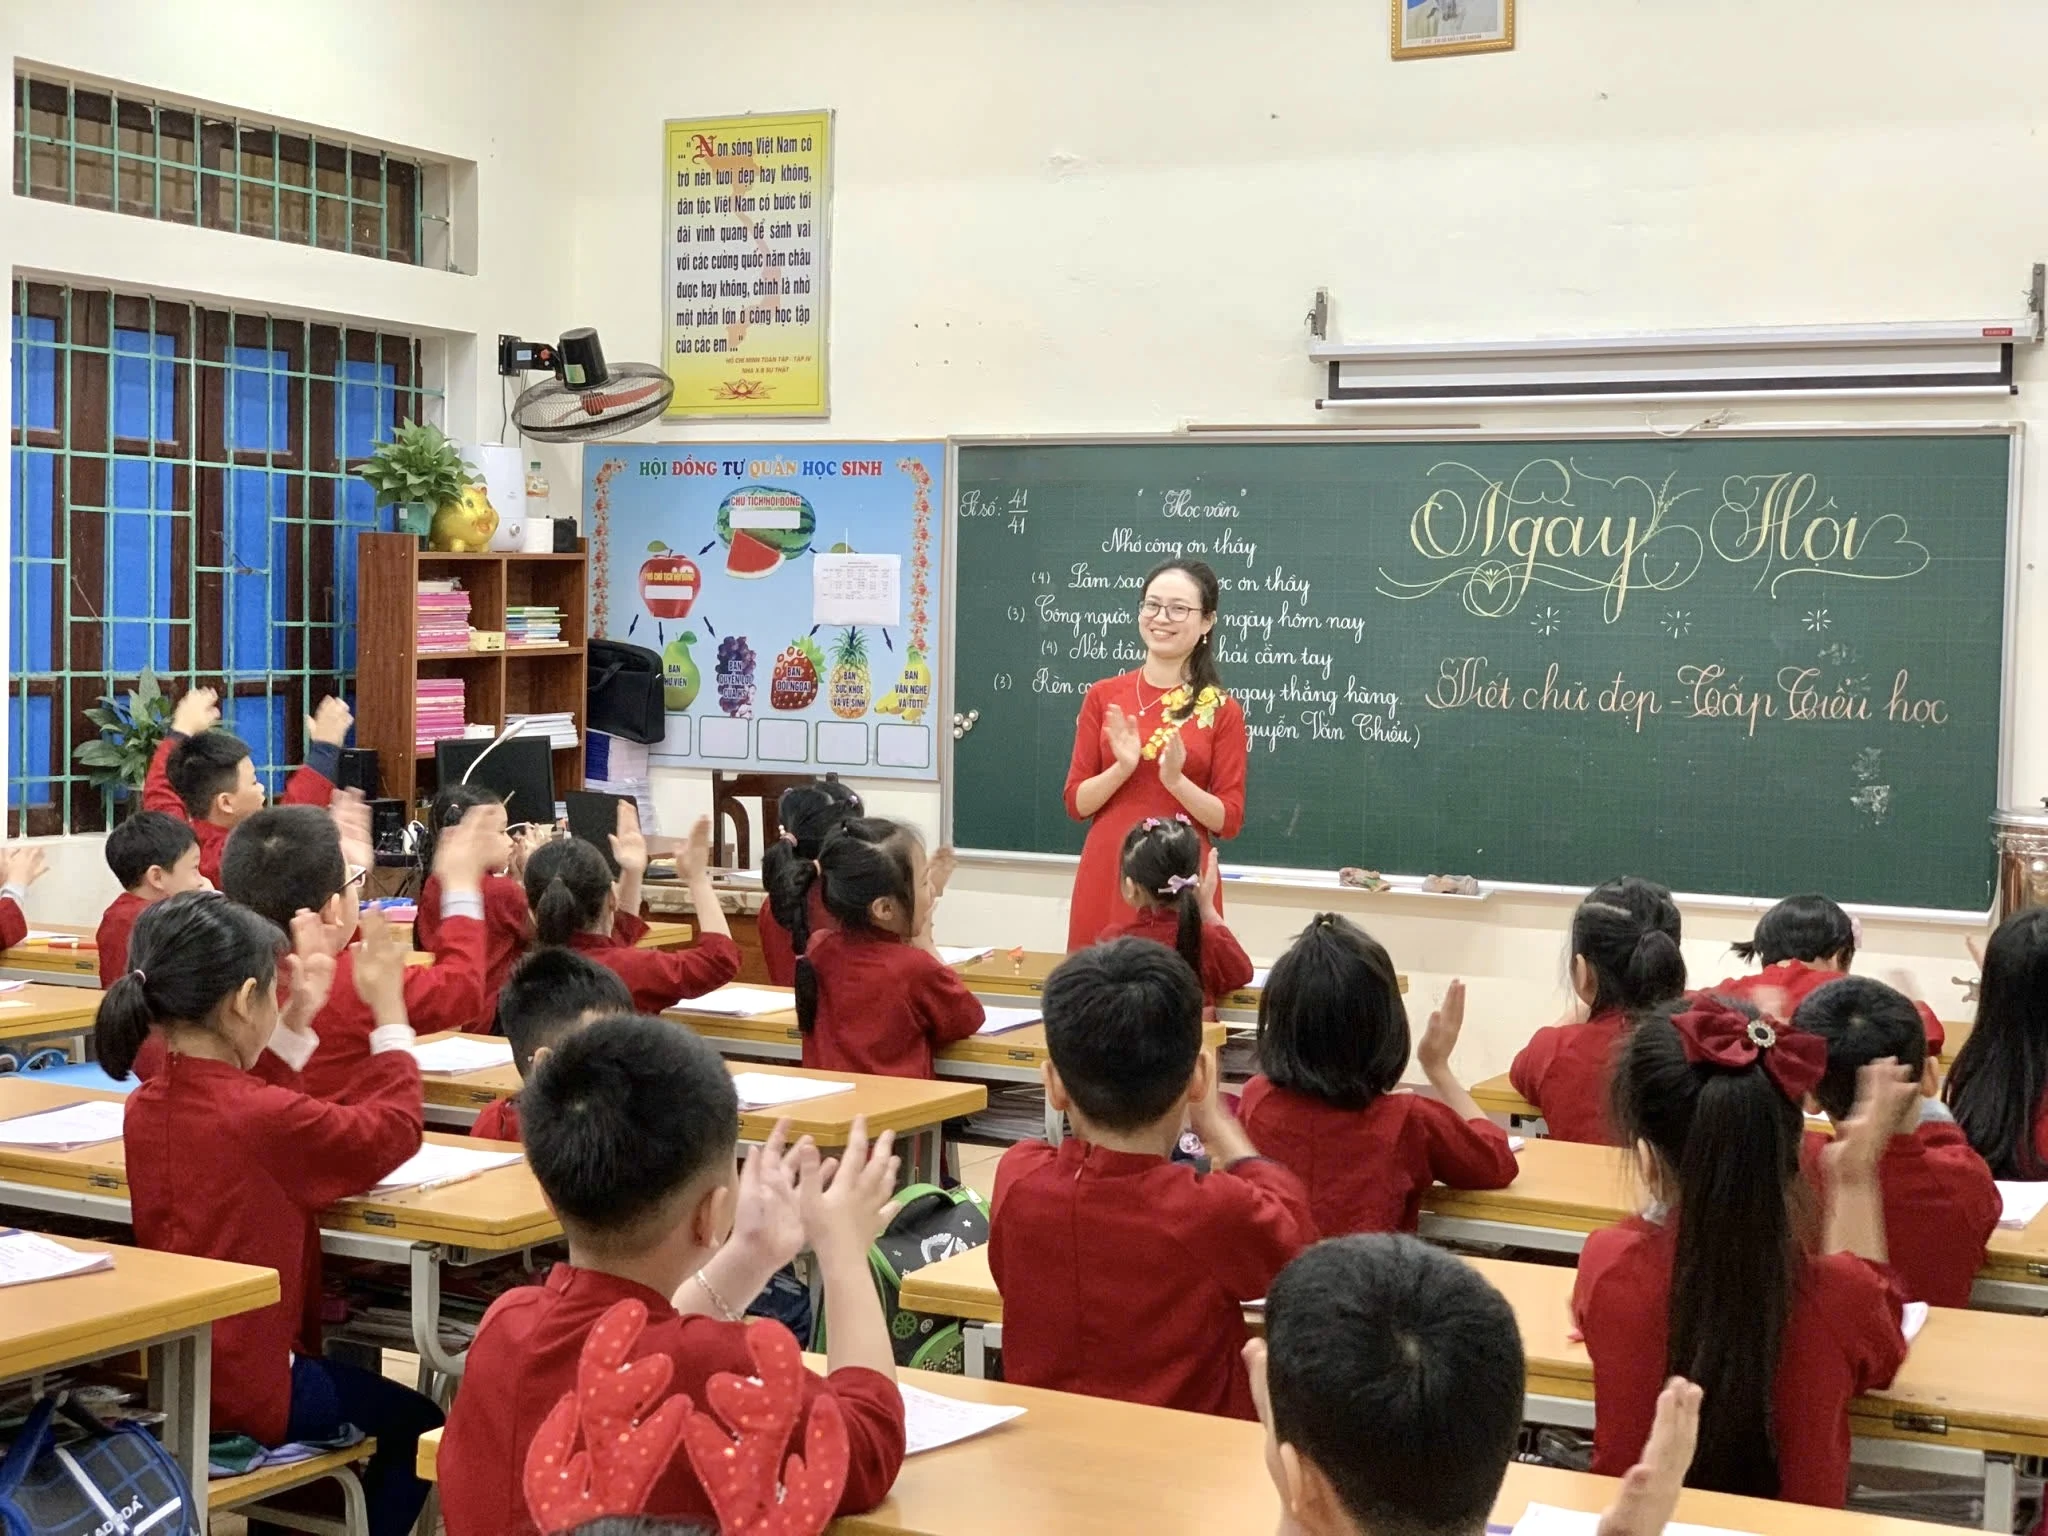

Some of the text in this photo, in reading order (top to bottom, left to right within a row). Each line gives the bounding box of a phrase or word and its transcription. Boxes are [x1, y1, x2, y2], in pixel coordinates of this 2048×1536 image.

[756, 136, 773, 158] Việt
[777, 136, 797, 153] Nam
[695, 169, 711, 186] nên
[738, 167, 754, 187] đẹp
[760, 165, 776, 184] hay
[678, 192, 811, 218] dân tộc Việt Nam có bước tới
[677, 225, 691, 243] đài
[721, 226, 748, 243] quang
[754, 218, 766, 239] để
[770, 221, 791, 240] sánh
[797, 220, 811, 238] vai
[677, 247, 811, 270] với các cường quốc năm châu
[677, 281, 698, 301] được
[701, 281, 717, 299] hay
[720, 279, 750, 299] không,
[782, 276, 790, 295] là
[793, 274, 810, 294] nhờ
[676, 308, 693, 330] một
[722, 306, 736, 325] lớn
[750, 307, 771, 326] công
[775, 306, 792, 327] học
[796, 304, 810, 326] tập
[676, 335, 692, 353] của
[695, 336, 711, 353] các
[639, 457, 667, 480] HỘI
[672, 453, 717, 477] ĐỒNG
[723, 458, 746, 480] TỰ
[802, 461, 836, 480] HỌC
[841, 461, 882, 476] SINH
[977, 496, 1002, 517] số:
[1008, 488, 1028, 509] 41
[1007, 515, 1025, 534] 41
[1102, 528, 1257, 568] Nhớ công ơn thầy
[1031, 571, 1051, 584] (4)
[1068, 563, 1110, 589] Làm
[1113, 575, 1145, 589] sao
[1238, 577, 1259, 591] ơn
[1265, 566, 1310, 606] thầy
[1007, 606, 1025, 623] (3)
[1084, 607, 1133, 637] người
[1223, 609, 1273, 641] ngày
[1277, 600, 1322, 628] hôm
[1325, 616, 1366, 643] nay
[668, 664, 681, 673] BAN
[728, 661, 742, 671] BAN
[1041, 633, 1333, 680] (4) Nét đầu hải cầm tay
[787, 667, 801, 676] BAN
[844, 671, 856, 680] BAN
[904, 670, 918, 680] BAN
[993, 673, 1012, 690] (3)
[1032, 667, 1074, 694] Rèn
[1226, 687, 1275, 714] ngay
[1280, 675, 1338, 715] thẳng
[1425, 656, 1515, 709] Viết
[1522, 662, 1590, 710] chữ
[1598, 671, 1663, 733] đẹp
[1882, 669, 1948, 728] học
[1244, 711, 1300, 752] guyễn
[1301, 710, 1346, 741] Văn
